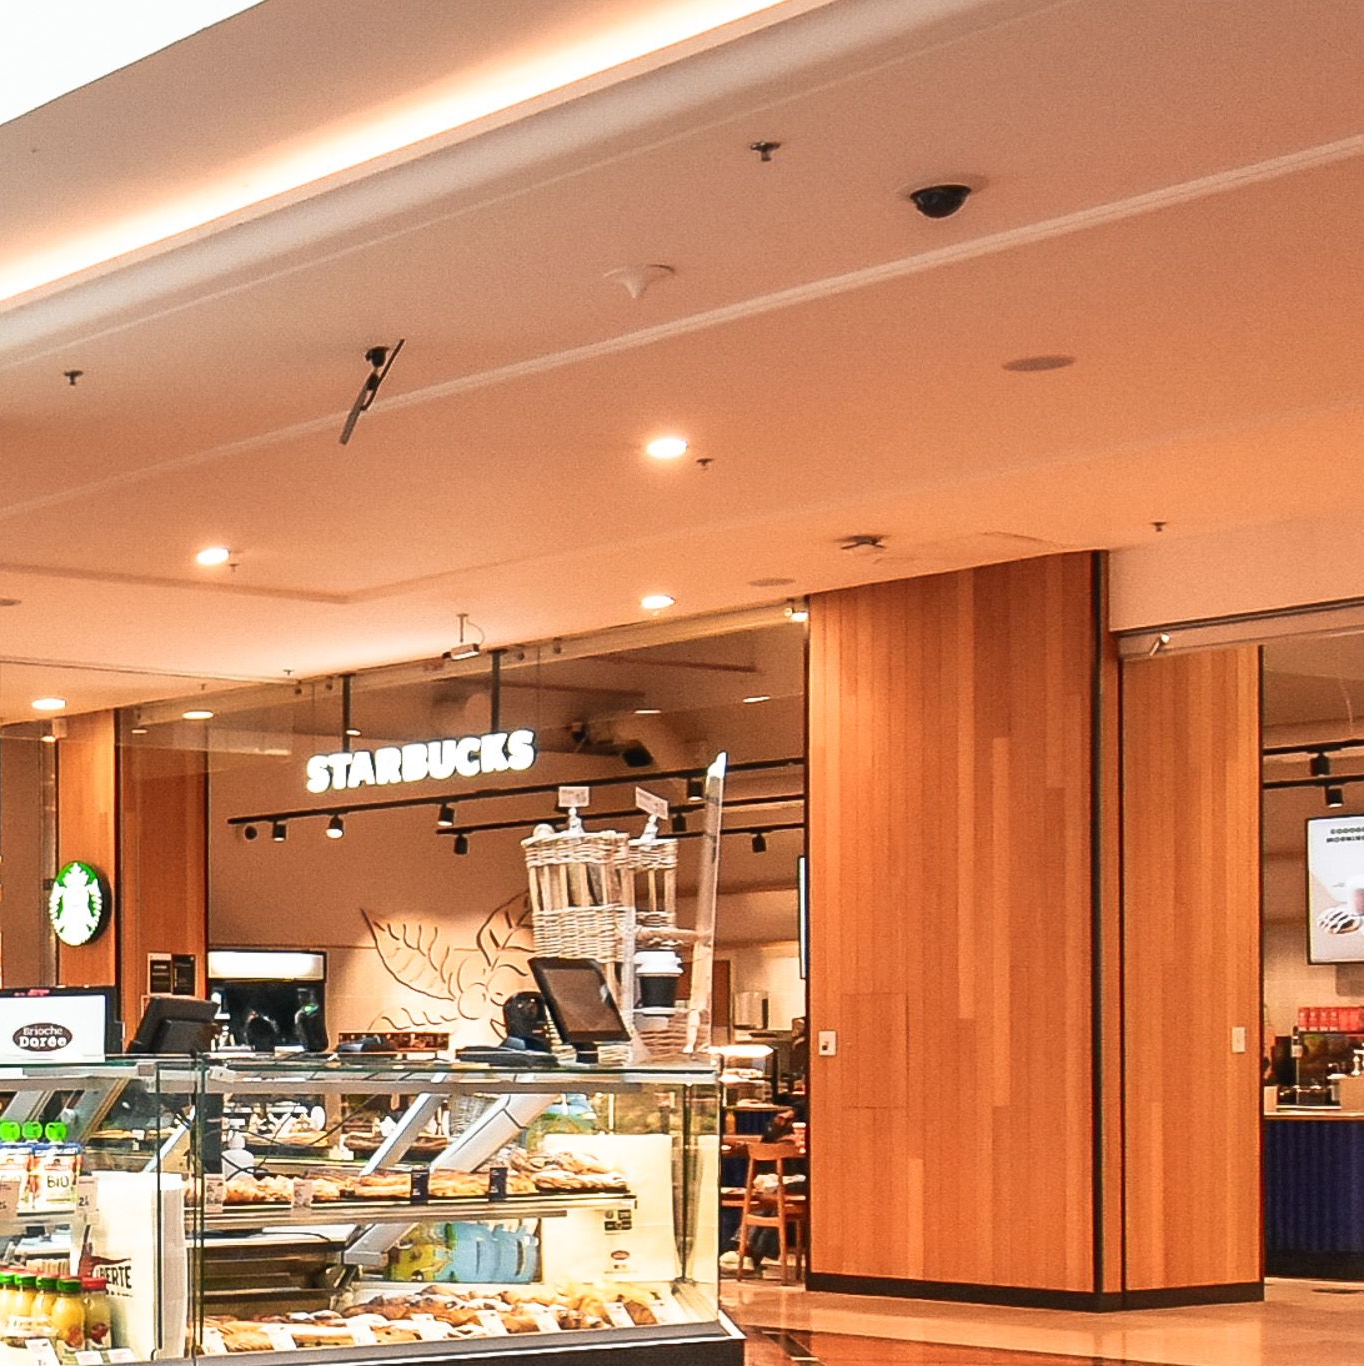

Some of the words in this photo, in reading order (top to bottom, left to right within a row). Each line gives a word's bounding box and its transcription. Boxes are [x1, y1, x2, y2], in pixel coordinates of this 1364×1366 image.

[306, 729, 538, 794] STARBUCKS
[23, 1026, 63, 1036] Brioche
[19, 1035, 68, 1048] Dorée
